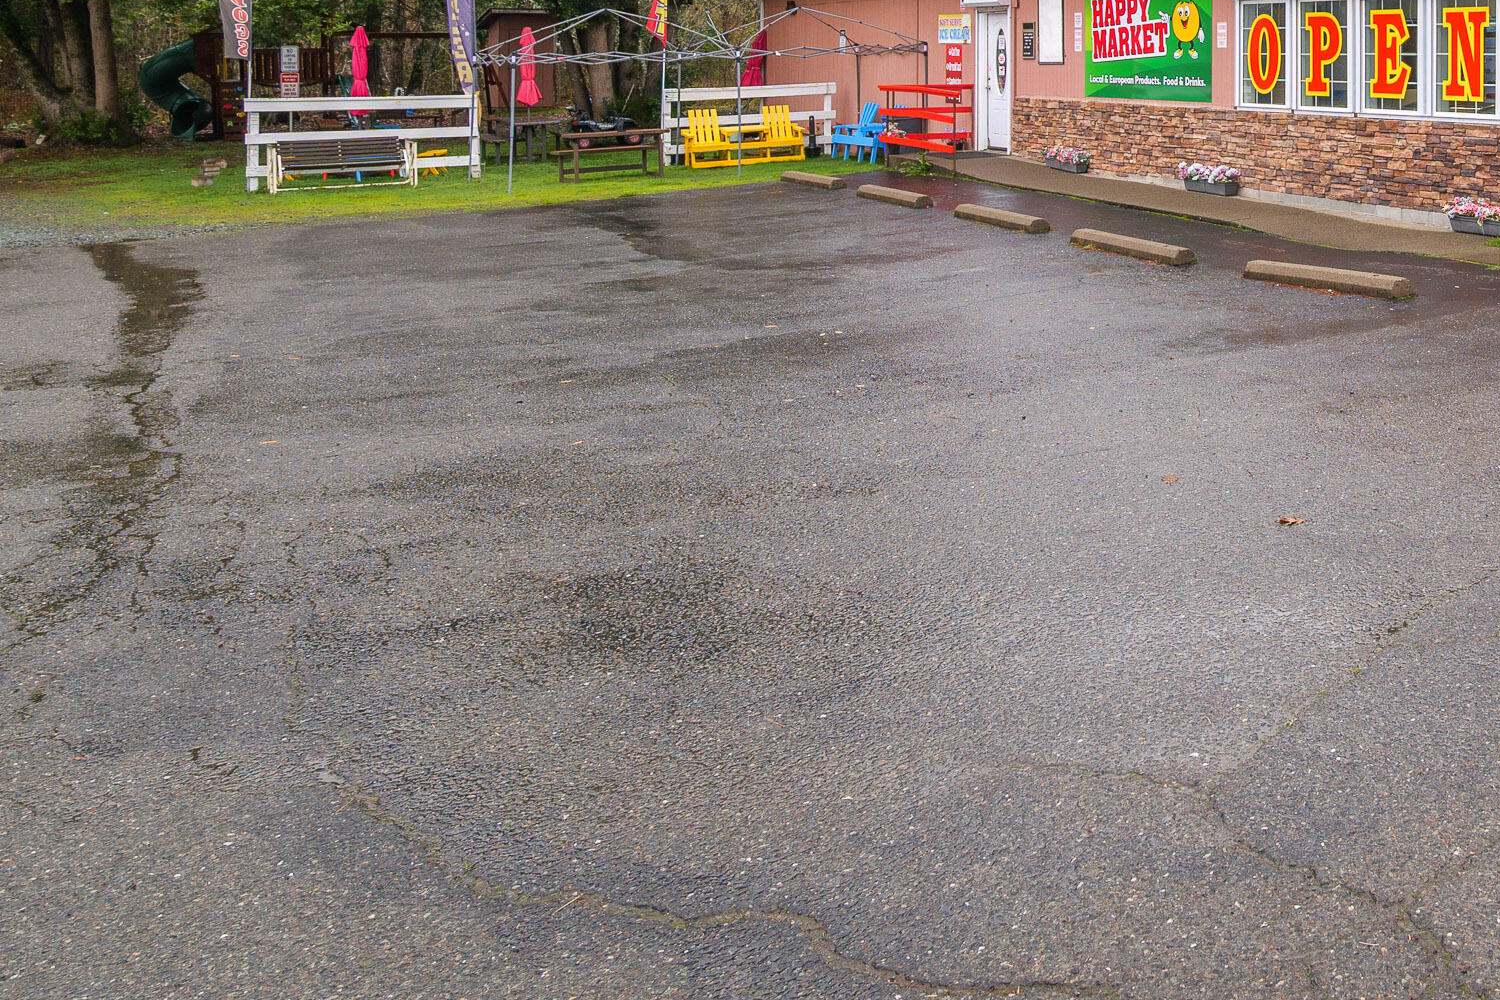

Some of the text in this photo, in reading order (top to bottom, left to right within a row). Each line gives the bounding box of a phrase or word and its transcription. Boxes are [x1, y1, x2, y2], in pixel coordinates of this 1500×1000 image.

[939, 28, 949, 40] ICE
[1092, 22, 1168, 59] MARKET
[1248, 7, 1490, 102] OPEN
[1089, 74, 1206, 87] Local & European Products. Food & Drinks.
